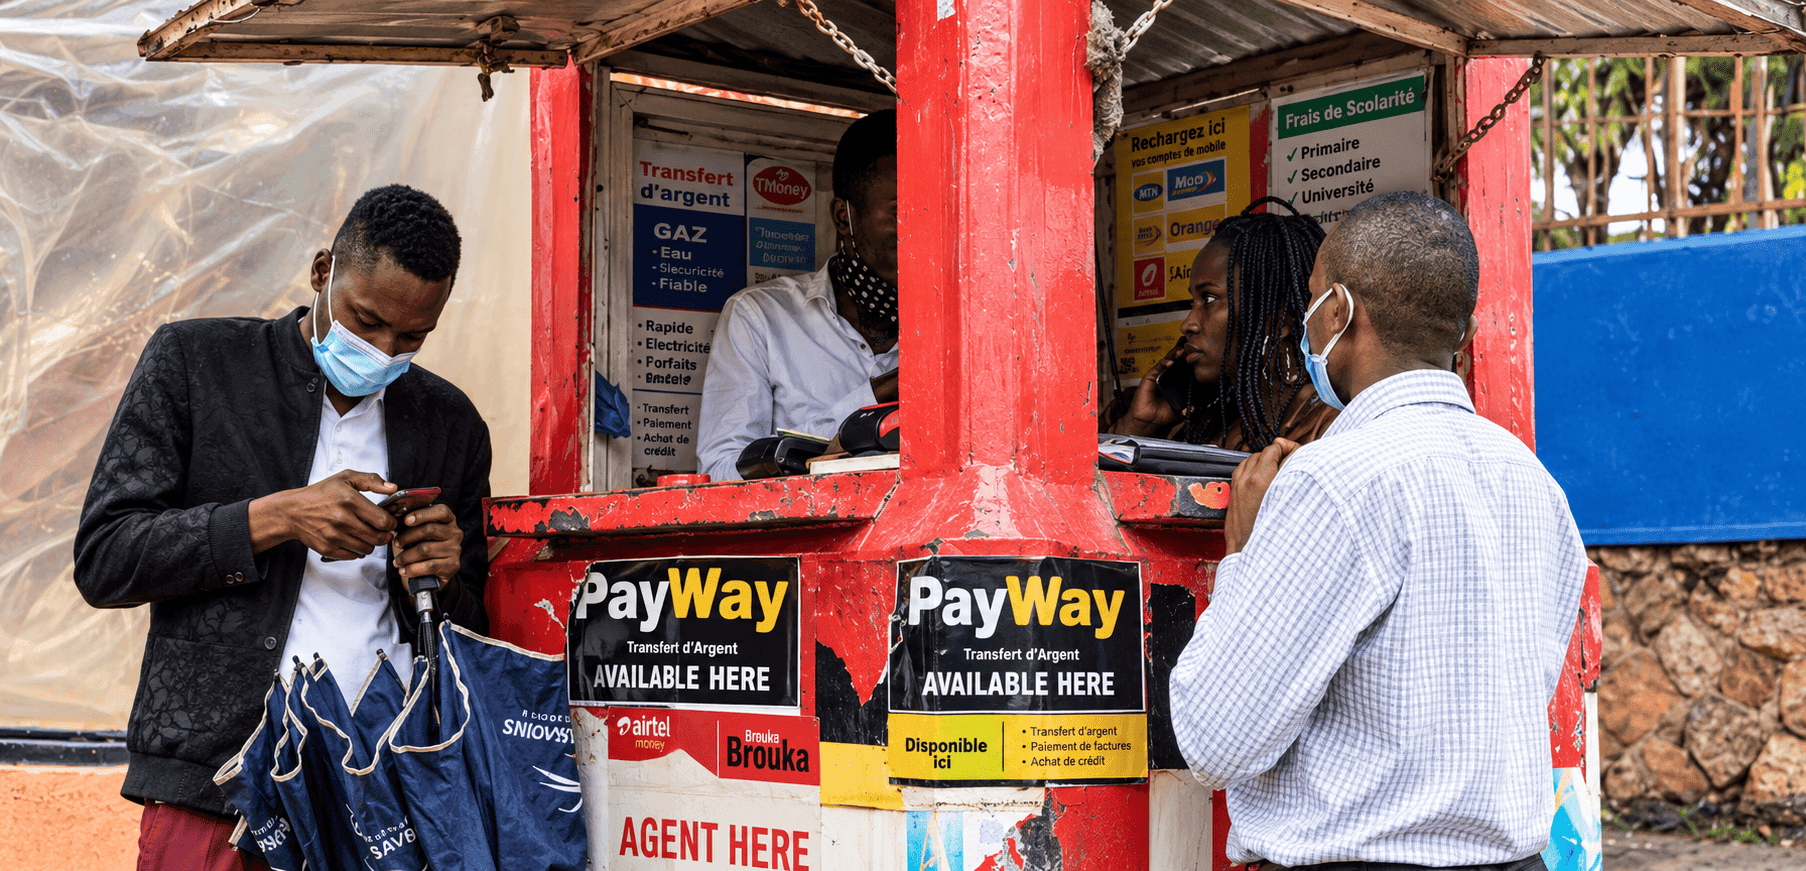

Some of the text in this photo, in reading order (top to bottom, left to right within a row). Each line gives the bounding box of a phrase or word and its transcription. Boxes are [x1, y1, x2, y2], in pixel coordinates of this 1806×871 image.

[1286, 87, 1415, 129] Frais de Scolarité
[1131, 117, 1225, 152] Rechargez ici
[1131, 140, 1226, 168] vos comptes de mobile
[1301, 138, 1360, 159] Primaire
[639, 160, 734, 187] Transfert
[1301, 157, 1381, 182] Secondaire
[640, 183, 731, 208] d'argent
[754, 177, 809, 200] TMoney
[1302, 178, 1375, 204] Université
[653, 222, 708, 244] GAZ
[660, 246, 692, 261] Eau
[659, 277, 708, 293] Fiable
[645, 319, 694, 336] Rapide
[645, 337, 711, 354] Electricité
[645, 355, 697, 371] Porfaits
[642, 403, 690, 415] Transfert
[643, 417, 692, 430] Paiement
[676, 434, 690, 444] de
[575, 567, 789, 633] PayWay
[908, 575, 1126, 639] PayWay
[626, 641, 739, 658] Transfert d'Argent
[963, 647, 1080, 663] Transfert d'Argent
[593, 664, 771, 692] AVAILABLE HERE
[921, 671, 1115, 697] AVAILABLE HERE
[632, 715, 671, 738] airtel
[745, 729, 780, 745] Brouka
[1030, 726, 1118, 739] Transfert d'argent
[727, 735, 810, 773] Brouka
[905, 737, 988, 756] Disponible
[1030, 740, 1132, 752] Paiement de factures
[933, 755, 951, 769] ici
[1030, 755, 1106, 767] Achat de crédit
[619, 816, 810, 871] AGENT HERE
